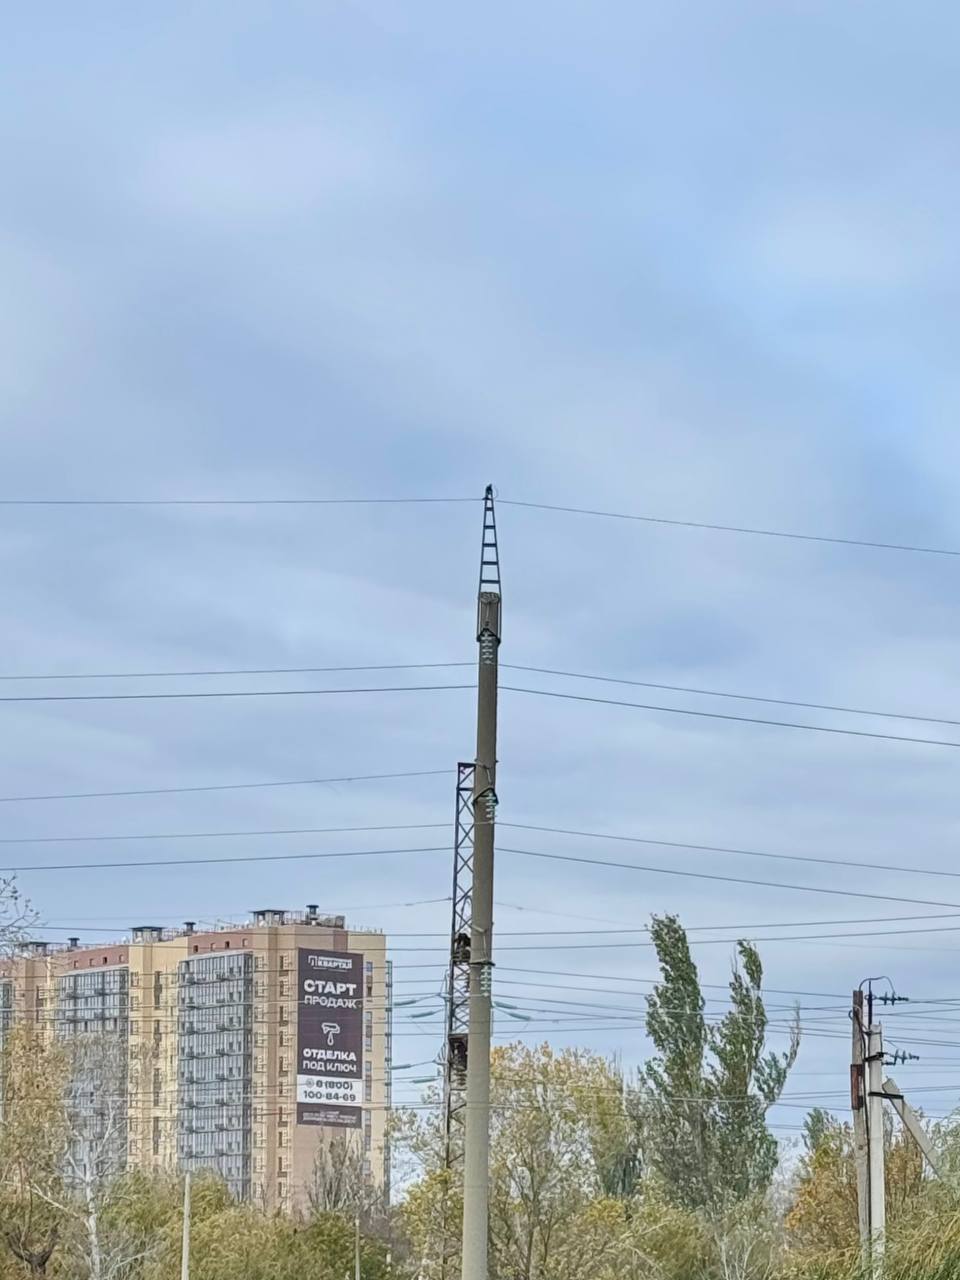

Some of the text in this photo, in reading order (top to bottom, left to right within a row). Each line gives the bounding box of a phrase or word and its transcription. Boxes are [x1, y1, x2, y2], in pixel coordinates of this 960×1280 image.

[303, 979, 357, 996] СТАРТ
[304, 995, 357, 1008] ПРОДАЖ
[303, 1048, 357, 1061] ОТДЕЛКА
[303, 1060, 357, 1072] ПОД КЛЮЧ
